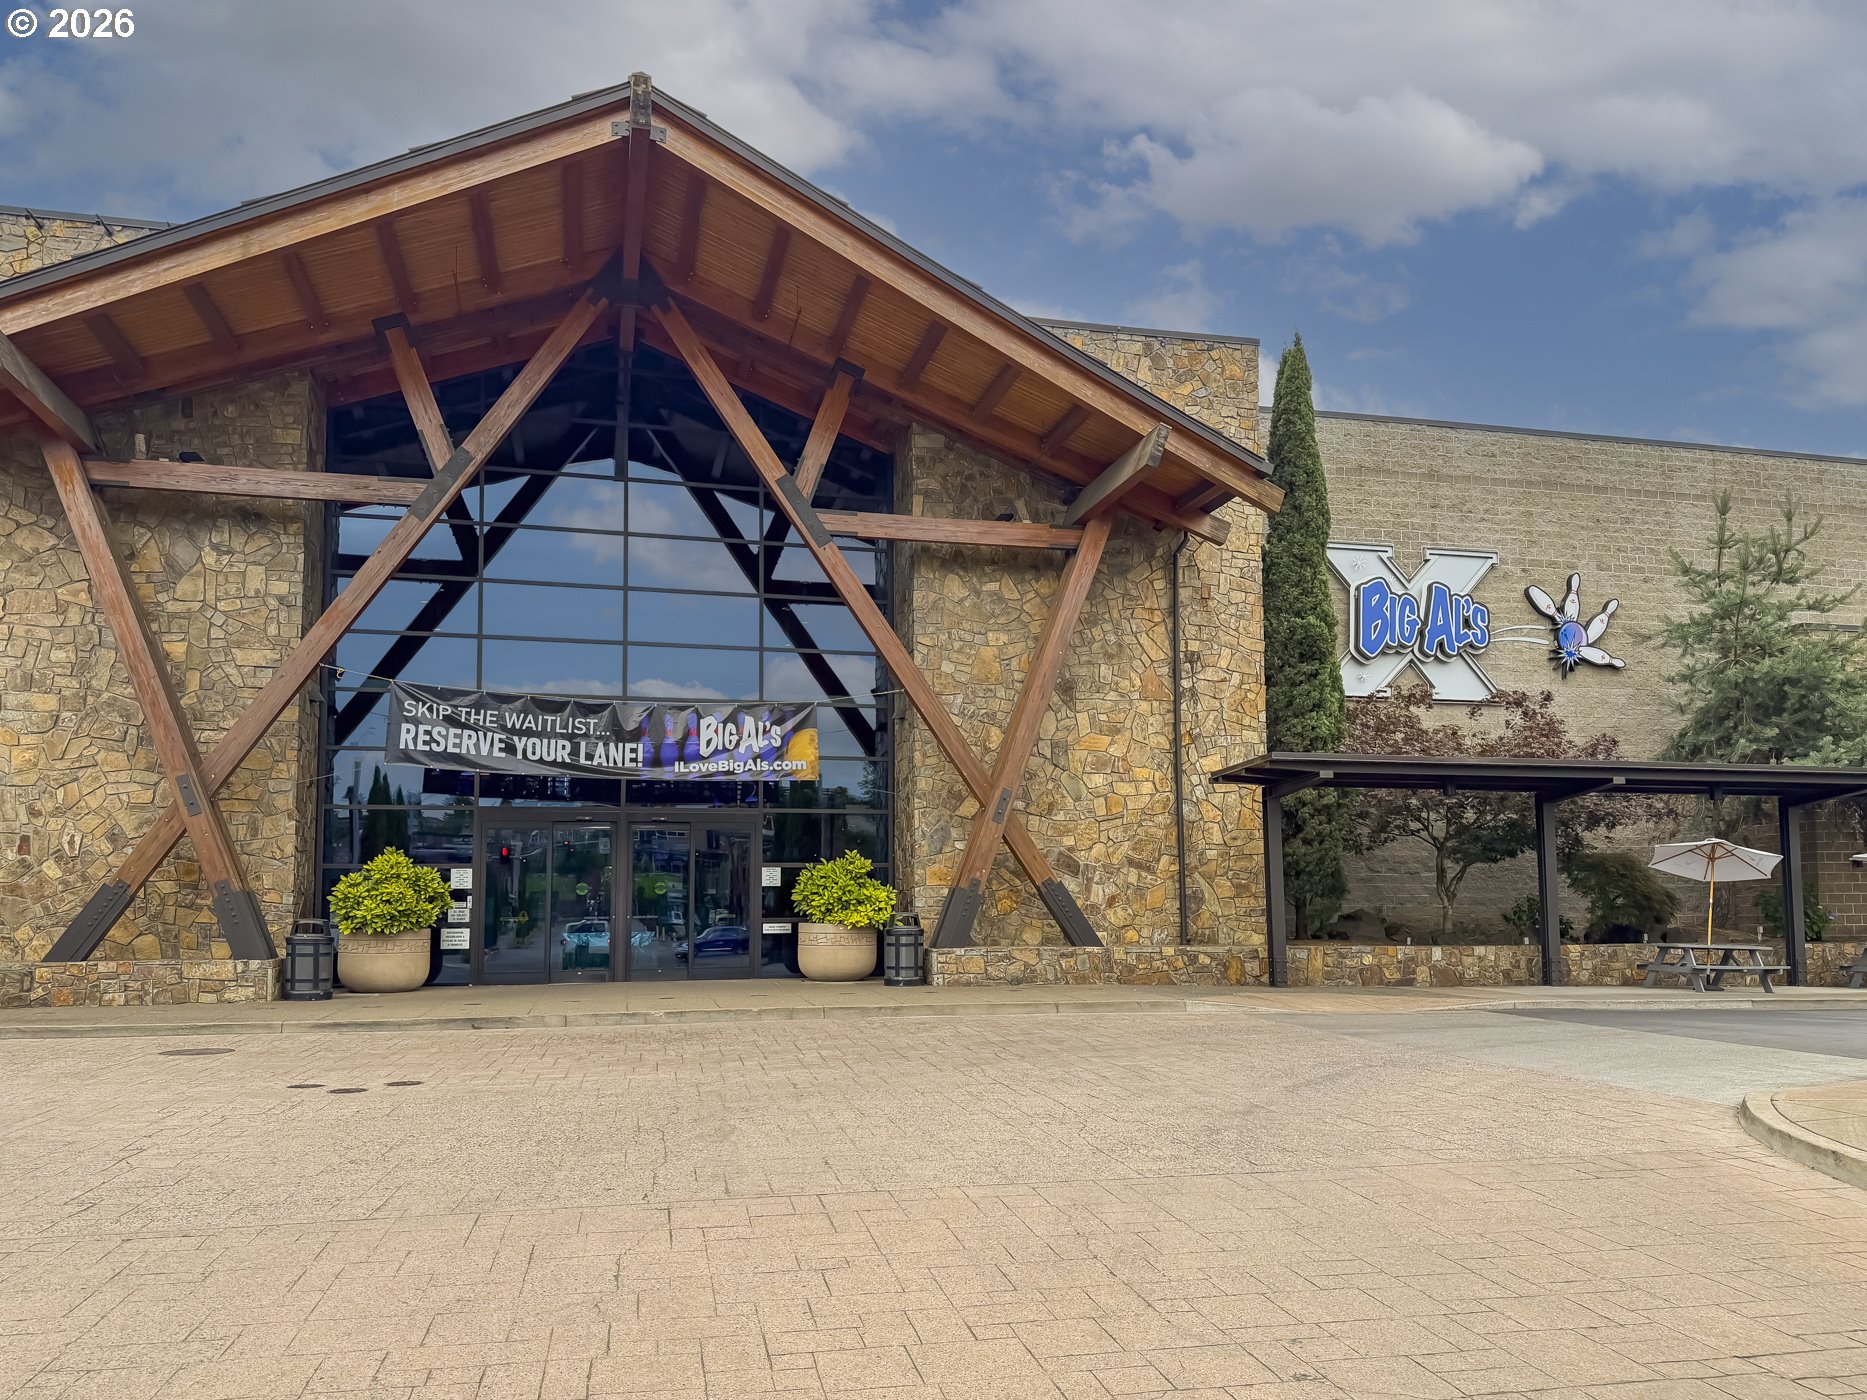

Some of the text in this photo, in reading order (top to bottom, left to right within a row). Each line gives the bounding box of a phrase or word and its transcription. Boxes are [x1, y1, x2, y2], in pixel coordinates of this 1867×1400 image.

[1357, 577, 1490, 658] BIG AL'S
[402, 700, 610, 735] SKIP THE WAITLIST...
[699, 715, 781, 758] BIG AL'S
[399, 722, 644, 767] RESERVE YOUR LANE!
[674, 758, 807, 774] ILoveBigAls.com
